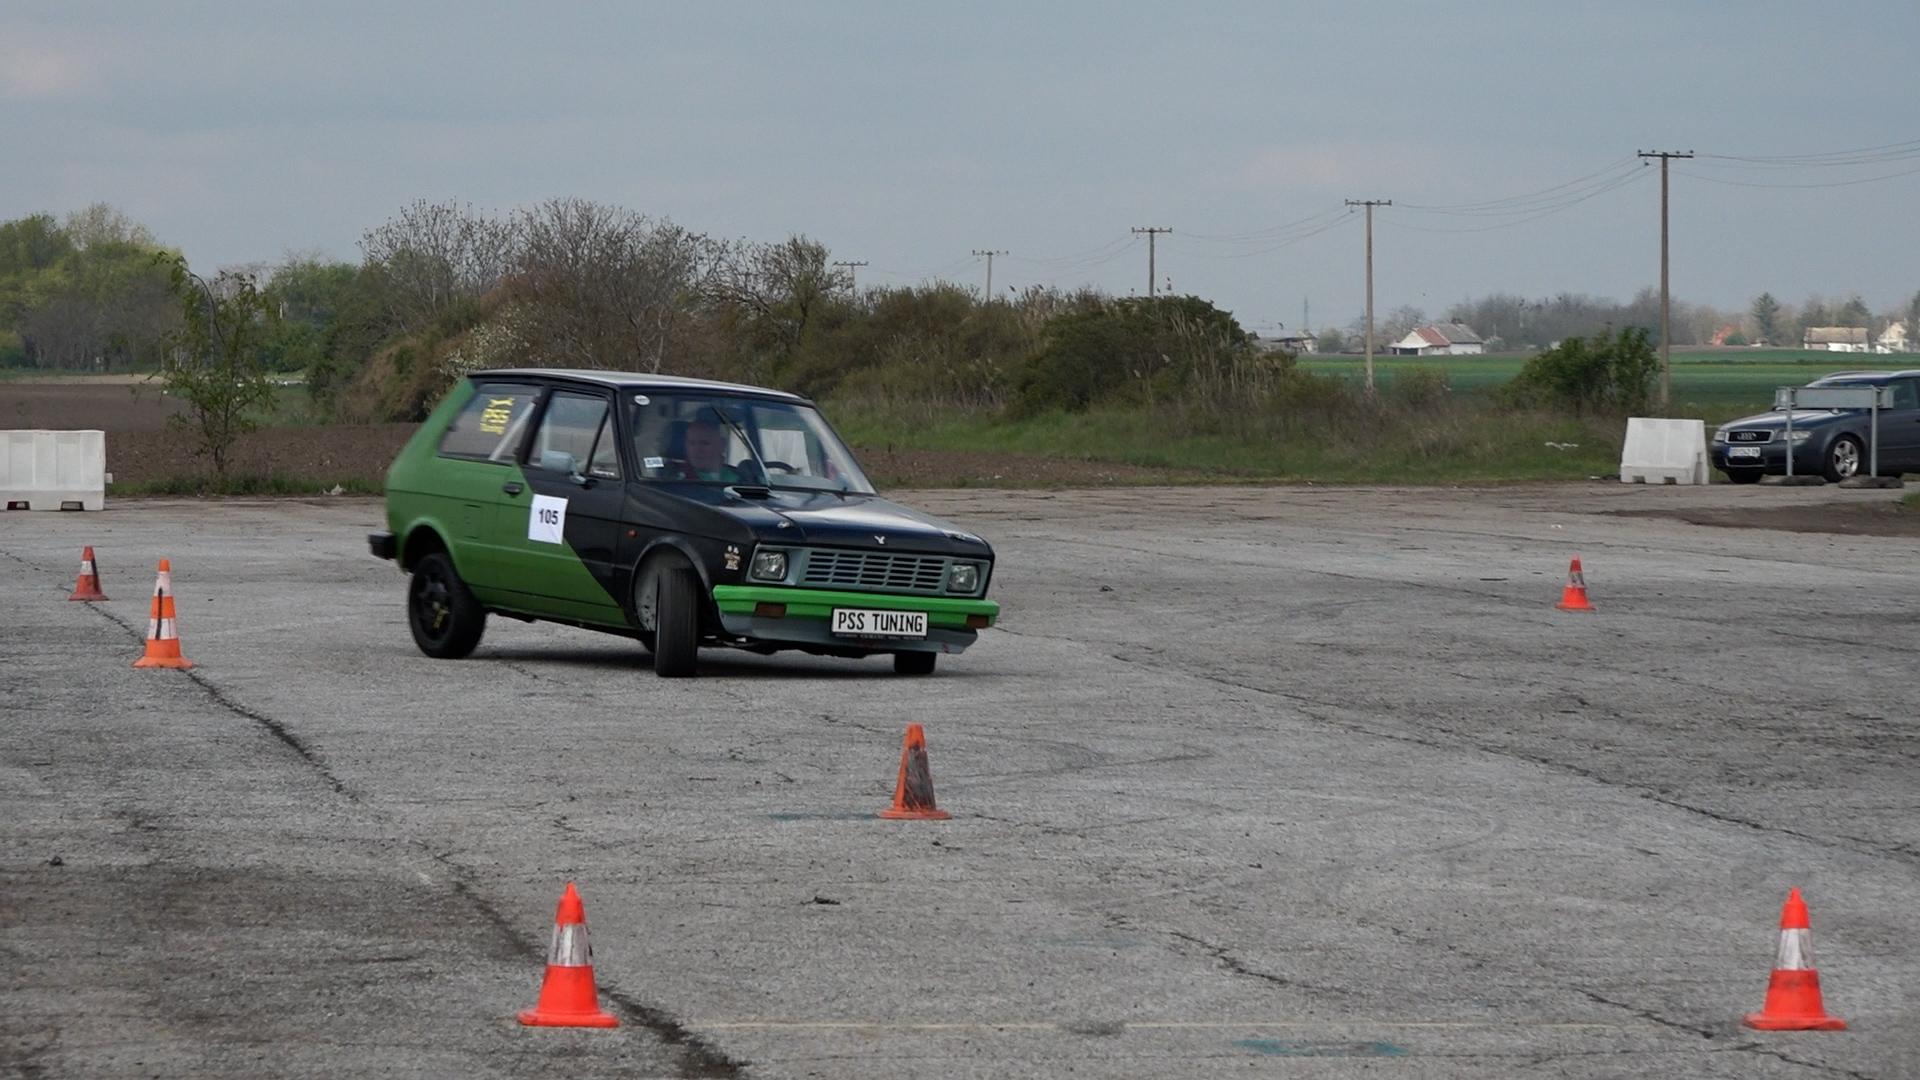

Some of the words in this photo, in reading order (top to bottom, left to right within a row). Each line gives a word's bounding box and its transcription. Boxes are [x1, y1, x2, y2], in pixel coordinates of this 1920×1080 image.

[538, 508, 559, 526] 105
[838, 611, 865, 631] PSS
[872, 613, 923, 633] TUNING
